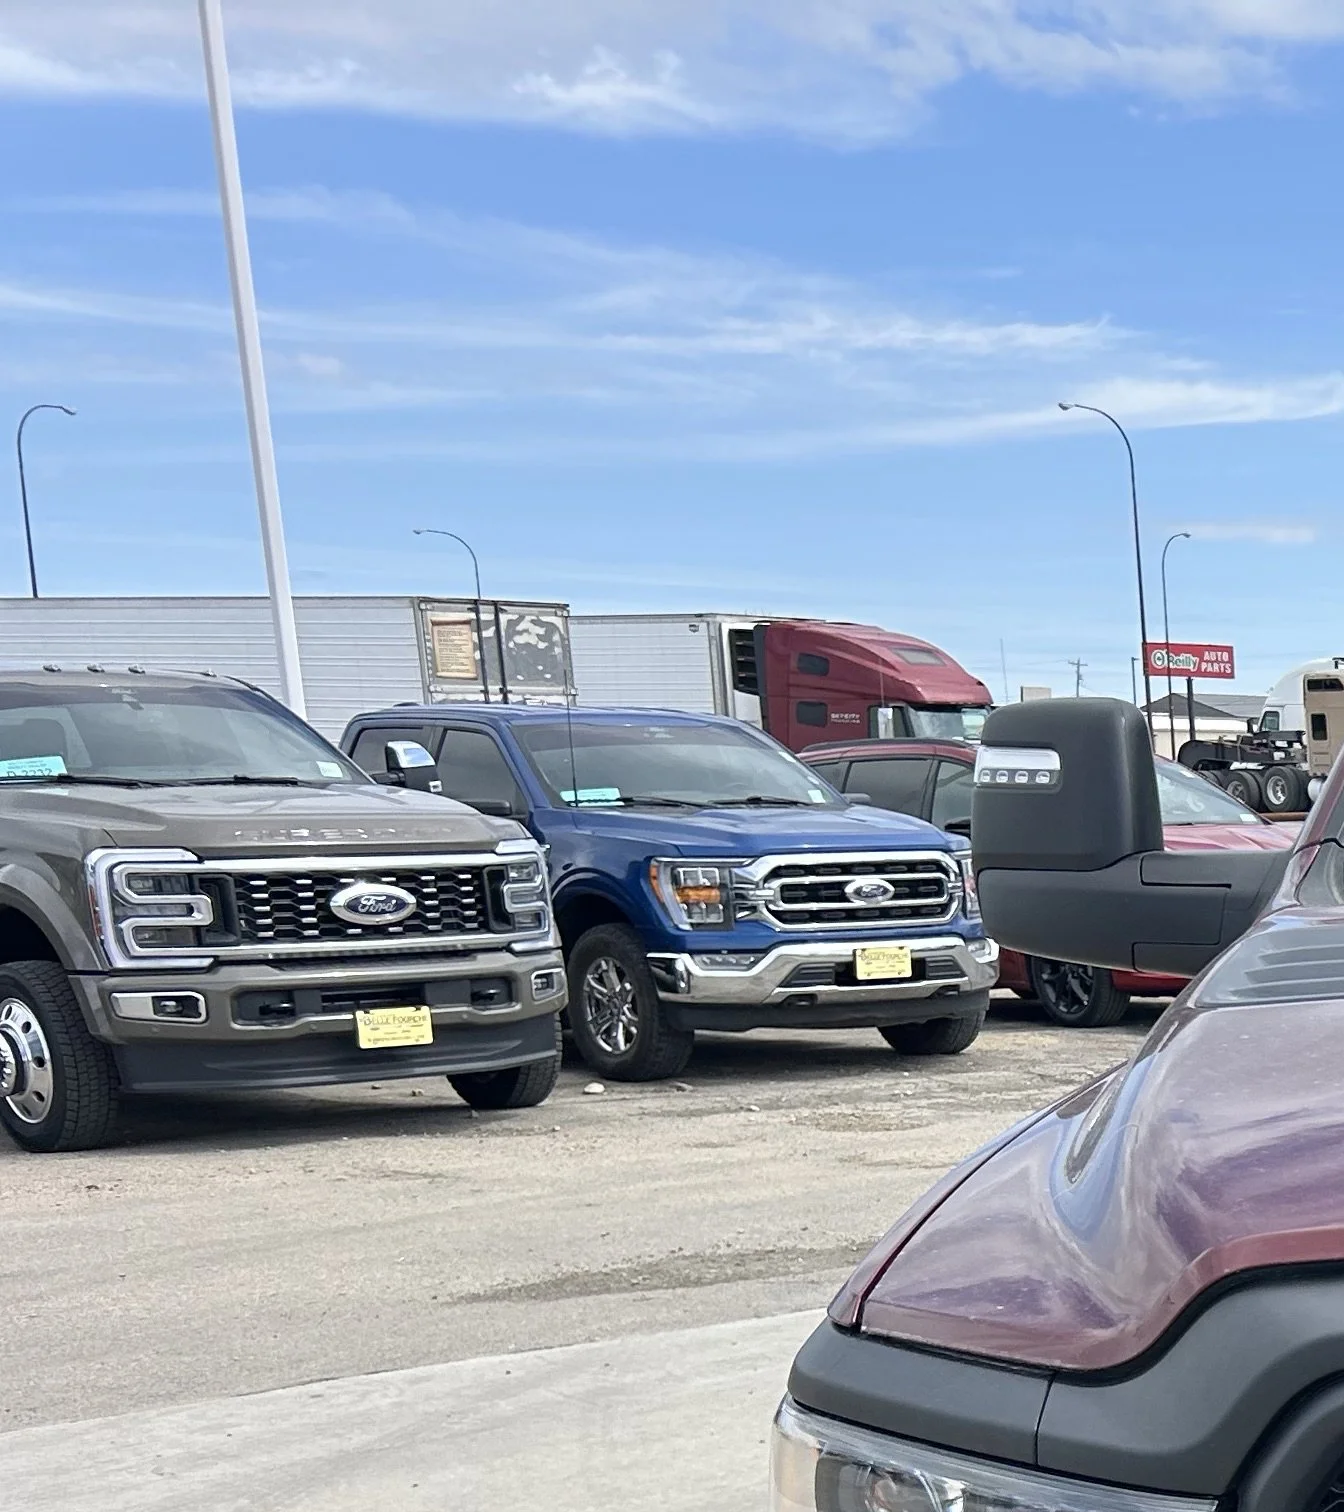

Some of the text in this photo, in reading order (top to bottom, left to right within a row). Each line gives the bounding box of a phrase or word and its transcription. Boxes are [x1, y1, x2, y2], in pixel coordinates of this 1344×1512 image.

[1151, 649, 1199, 672] O'Reilly
[1203, 651, 1229, 662] AUTO
[1200, 662, 1232, 674] PARTS
[357, 895, 397, 914] Ford
